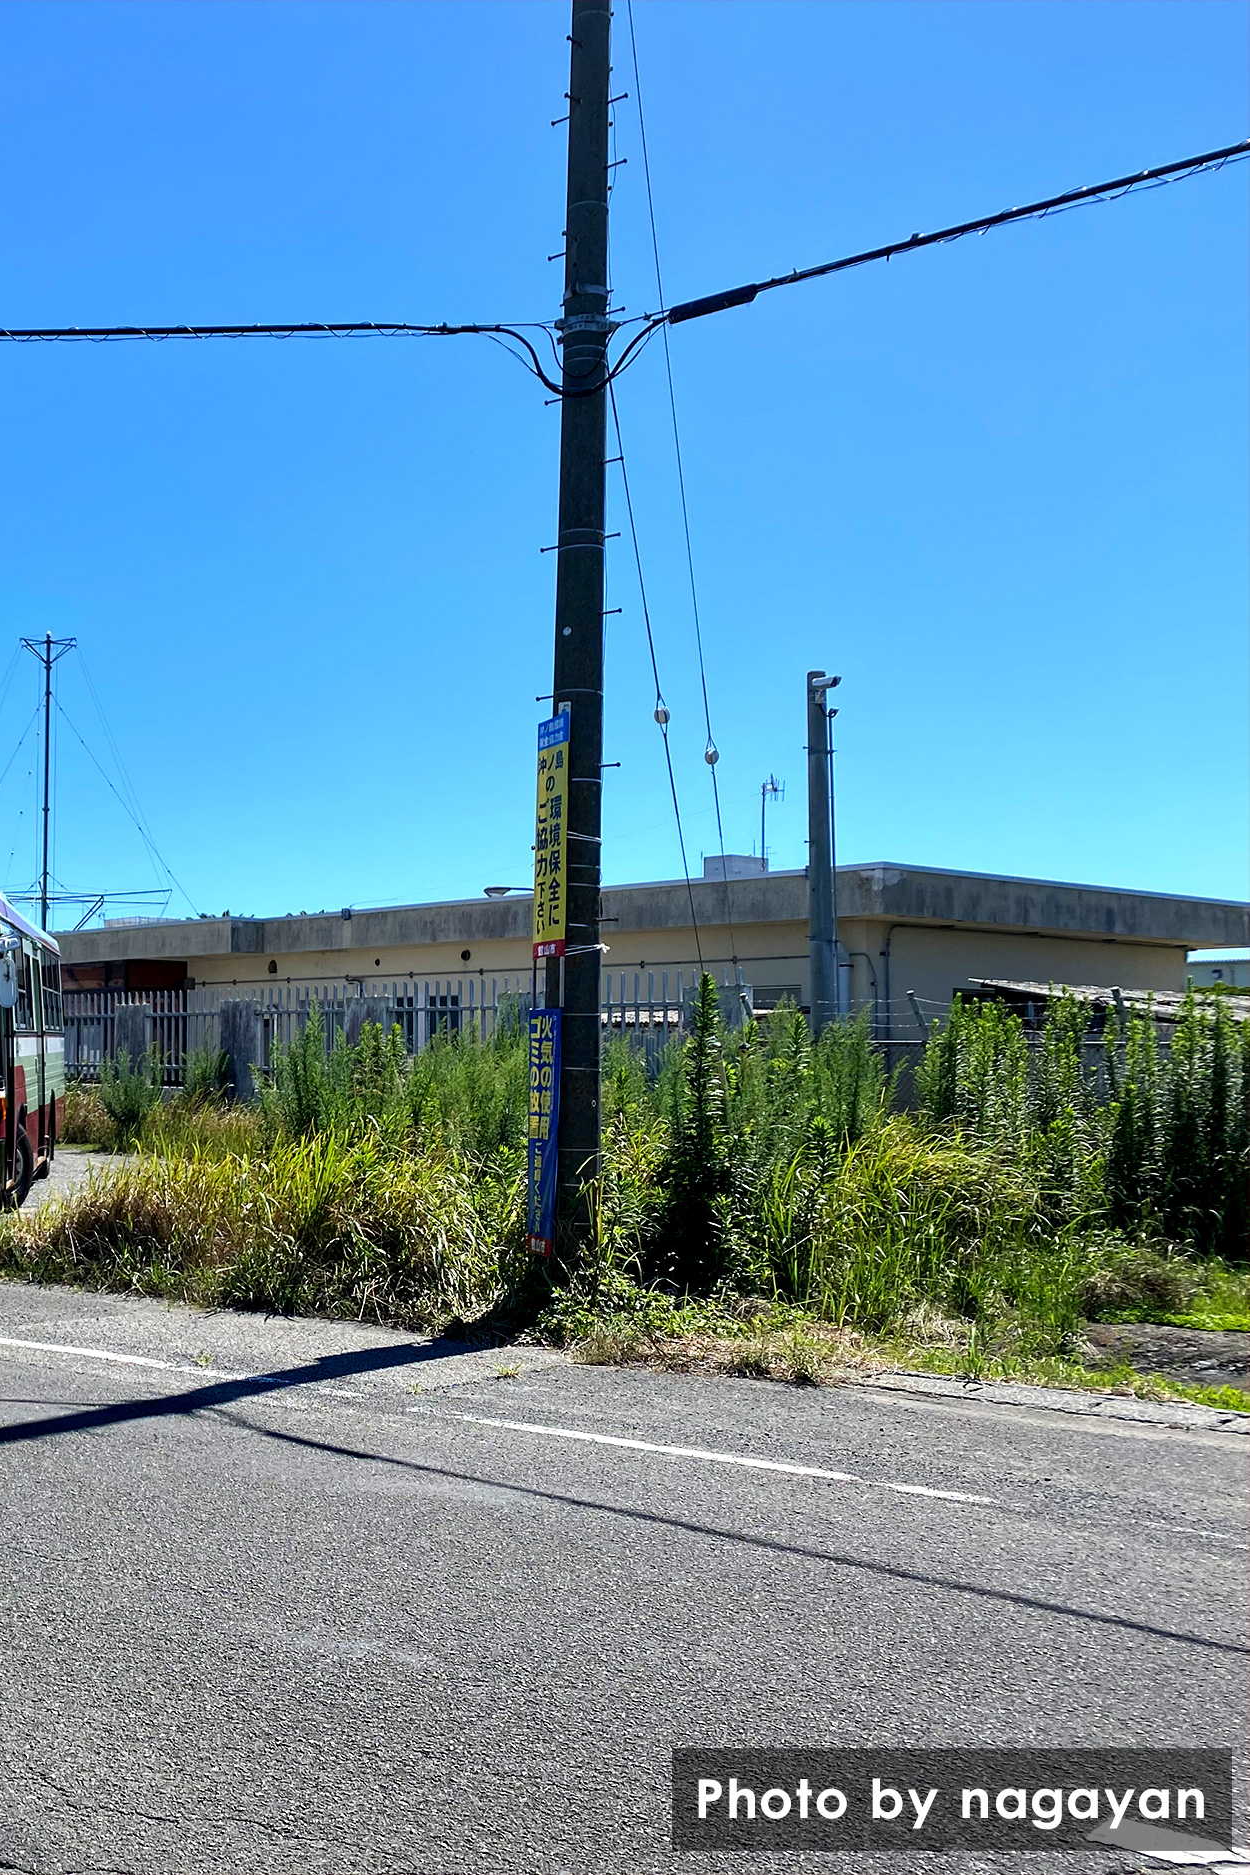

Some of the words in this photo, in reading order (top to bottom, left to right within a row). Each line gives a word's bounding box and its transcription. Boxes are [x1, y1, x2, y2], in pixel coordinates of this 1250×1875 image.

[536, 797, 550, 935] ご協力下さい
[548, 794, 563, 927] 環境保全に
[529, 1015, 542, 1139] ゴミの放置
[539, 1014, 553, 1140] 火気の使用
